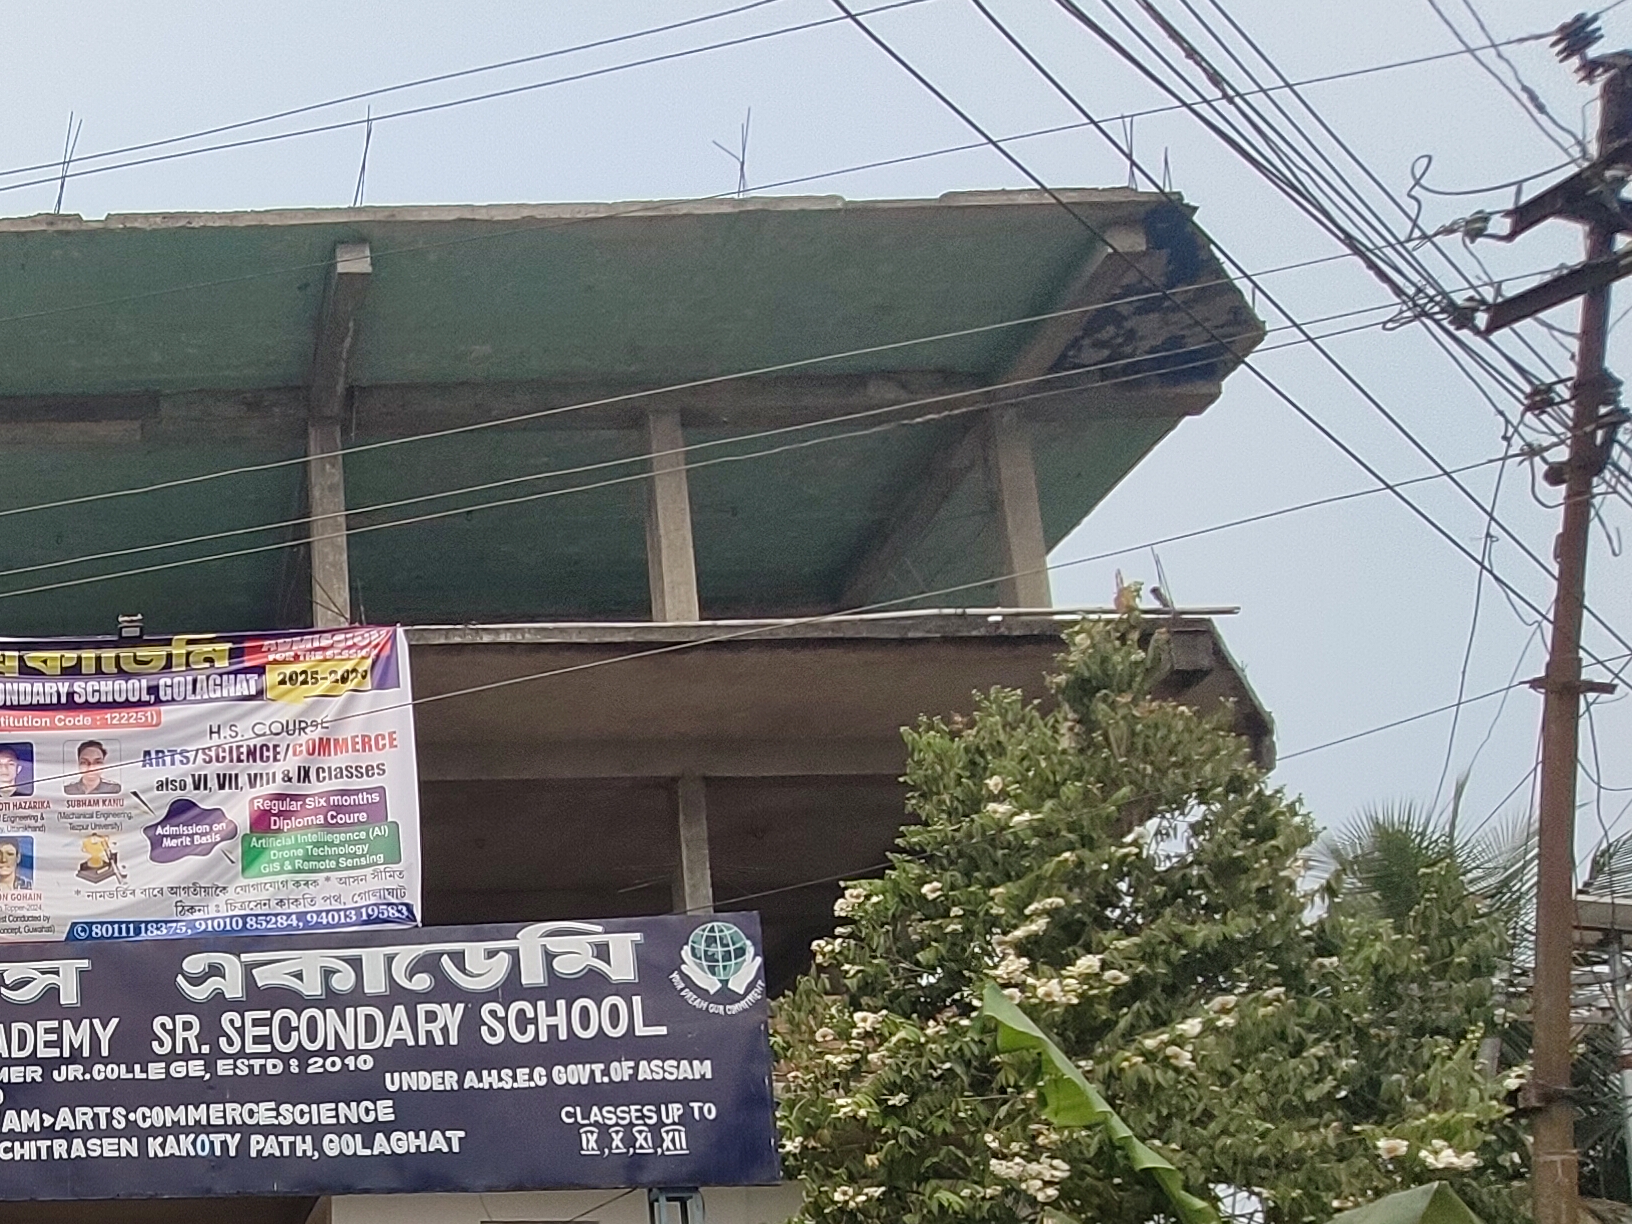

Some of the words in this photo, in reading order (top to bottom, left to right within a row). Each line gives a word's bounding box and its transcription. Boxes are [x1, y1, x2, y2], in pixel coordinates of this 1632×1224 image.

[159, 674, 258, 701] GOLAGHAT
[54, 714, 92, 726] Code
[104, 711, 157, 727] 122251)
[209, 724, 244, 740] H.S.
[156, 777, 187, 792] also
[317, 762, 386, 783] Classes
[254, 798, 302, 812] Regular
[305, 797, 326, 809] Six
[330, 791, 380, 805] months
[156, 824, 208, 835] Admission
[211, 822, 226, 831] on
[270, 816, 324, 831] Diploma
[328, 812, 367, 824] Coure
[162, 837, 191, 848] Merit
[194, 834, 220, 845] Basis
[250, 835, 294, 848] Artificial
[298, 831, 366, 844] Intelliegence
[369, 826, 389, 840] (AI)
[270, 849, 303, 859] Drone
[306, 843, 369, 858] Technology
[261, 863, 280, 873] GIS
[295, 859, 336, 870] Remote
[339, 853, 383, 868] Sensing
[11, 893, 42, 901] GOHAIN
[92, 924, 135, 938] 80111
[140, 922, 192, 936] 18375,
[195, 917, 242, 932] 91010
[246, 916, 303, 929] 85284,
[307, 911, 356, 924] 94013
[360, 905, 408, 919] 19583
[176, 921, 643, 1002] একাডেমি
[151, 1014, 211, 1054] SR.
[219, 1002, 463, 1055] SECONDARY
[479, 996, 668, 1045] SCHOOL
[306, 1055, 375, 1074] 2010
[385, 1070, 458, 1092] UNDER
[637, 1060, 712, 1082] ASSAM
[560, 1105, 657, 1125] CLASSES
[661, 1103, 683, 1123] UP
[689, 1102, 716, 1120] TO
[148, 1134, 240, 1159] KAKOTY
[250, 1136, 318, 1160] PATH,
[322, 1130, 466, 1157] GOLAGHAT
